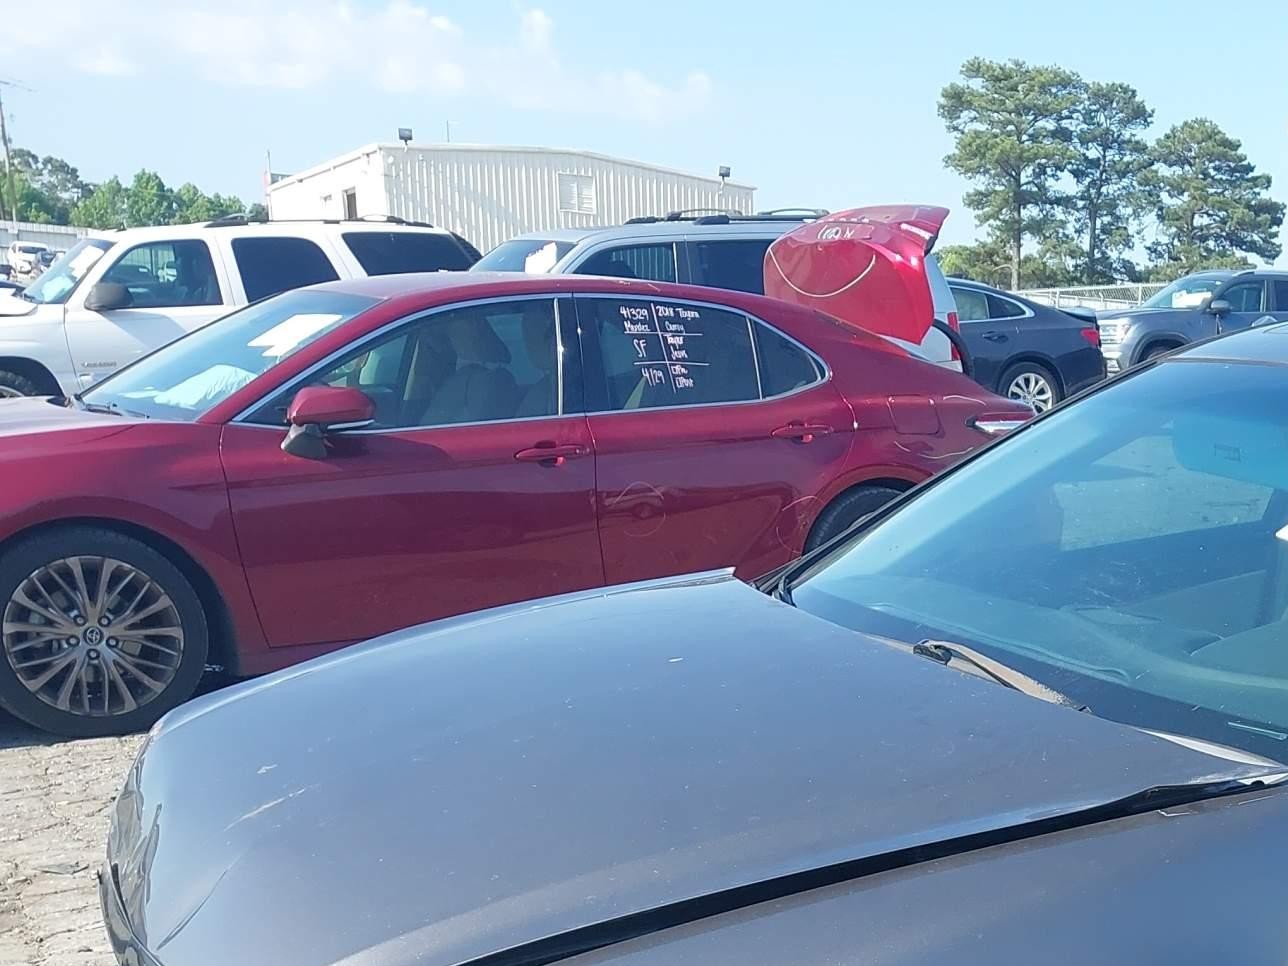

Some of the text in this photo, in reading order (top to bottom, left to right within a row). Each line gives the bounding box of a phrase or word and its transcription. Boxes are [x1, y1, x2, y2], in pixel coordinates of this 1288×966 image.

[620, 306, 649, 320] 41329
[656, 305, 675, 317] 2018
[633, 339, 647, 358] SF
[641, 367, 665, 387] 4/29
